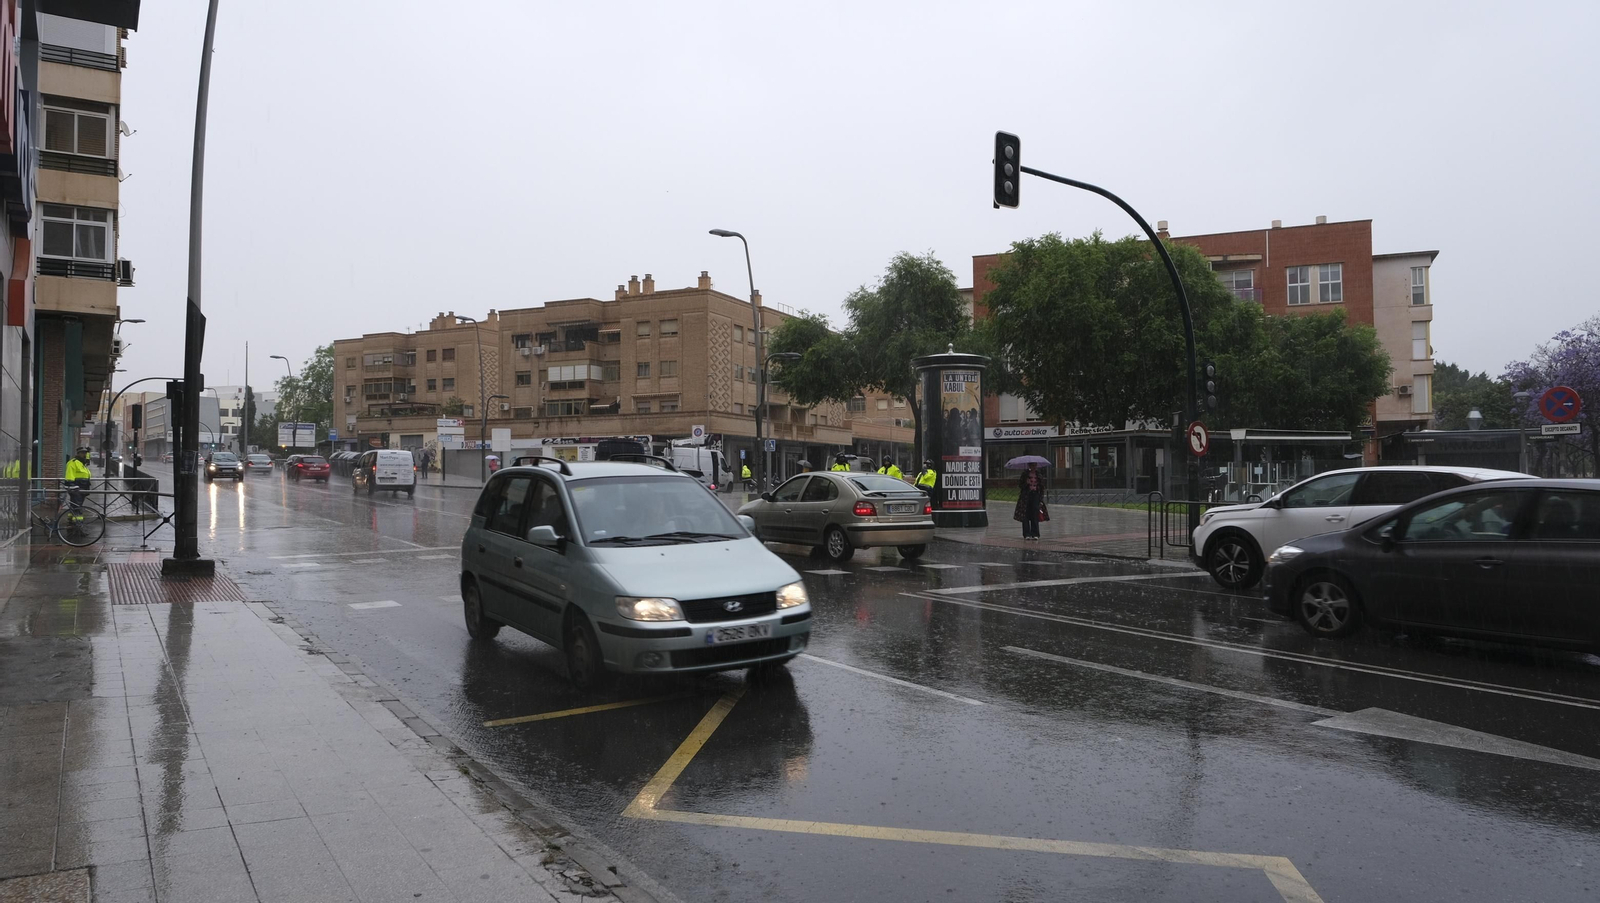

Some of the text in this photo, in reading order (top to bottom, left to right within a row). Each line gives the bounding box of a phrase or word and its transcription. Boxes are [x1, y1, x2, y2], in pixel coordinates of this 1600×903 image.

[943, 374, 953, 382] LA
[944, 382, 965, 393] KABUL
[1003, 427, 1048, 437] autocarbike
[945, 461, 981, 473] NADIE SABE
[944, 474, 968, 487] DÓNDE
[947, 489, 980, 501] LA UNIDAD
